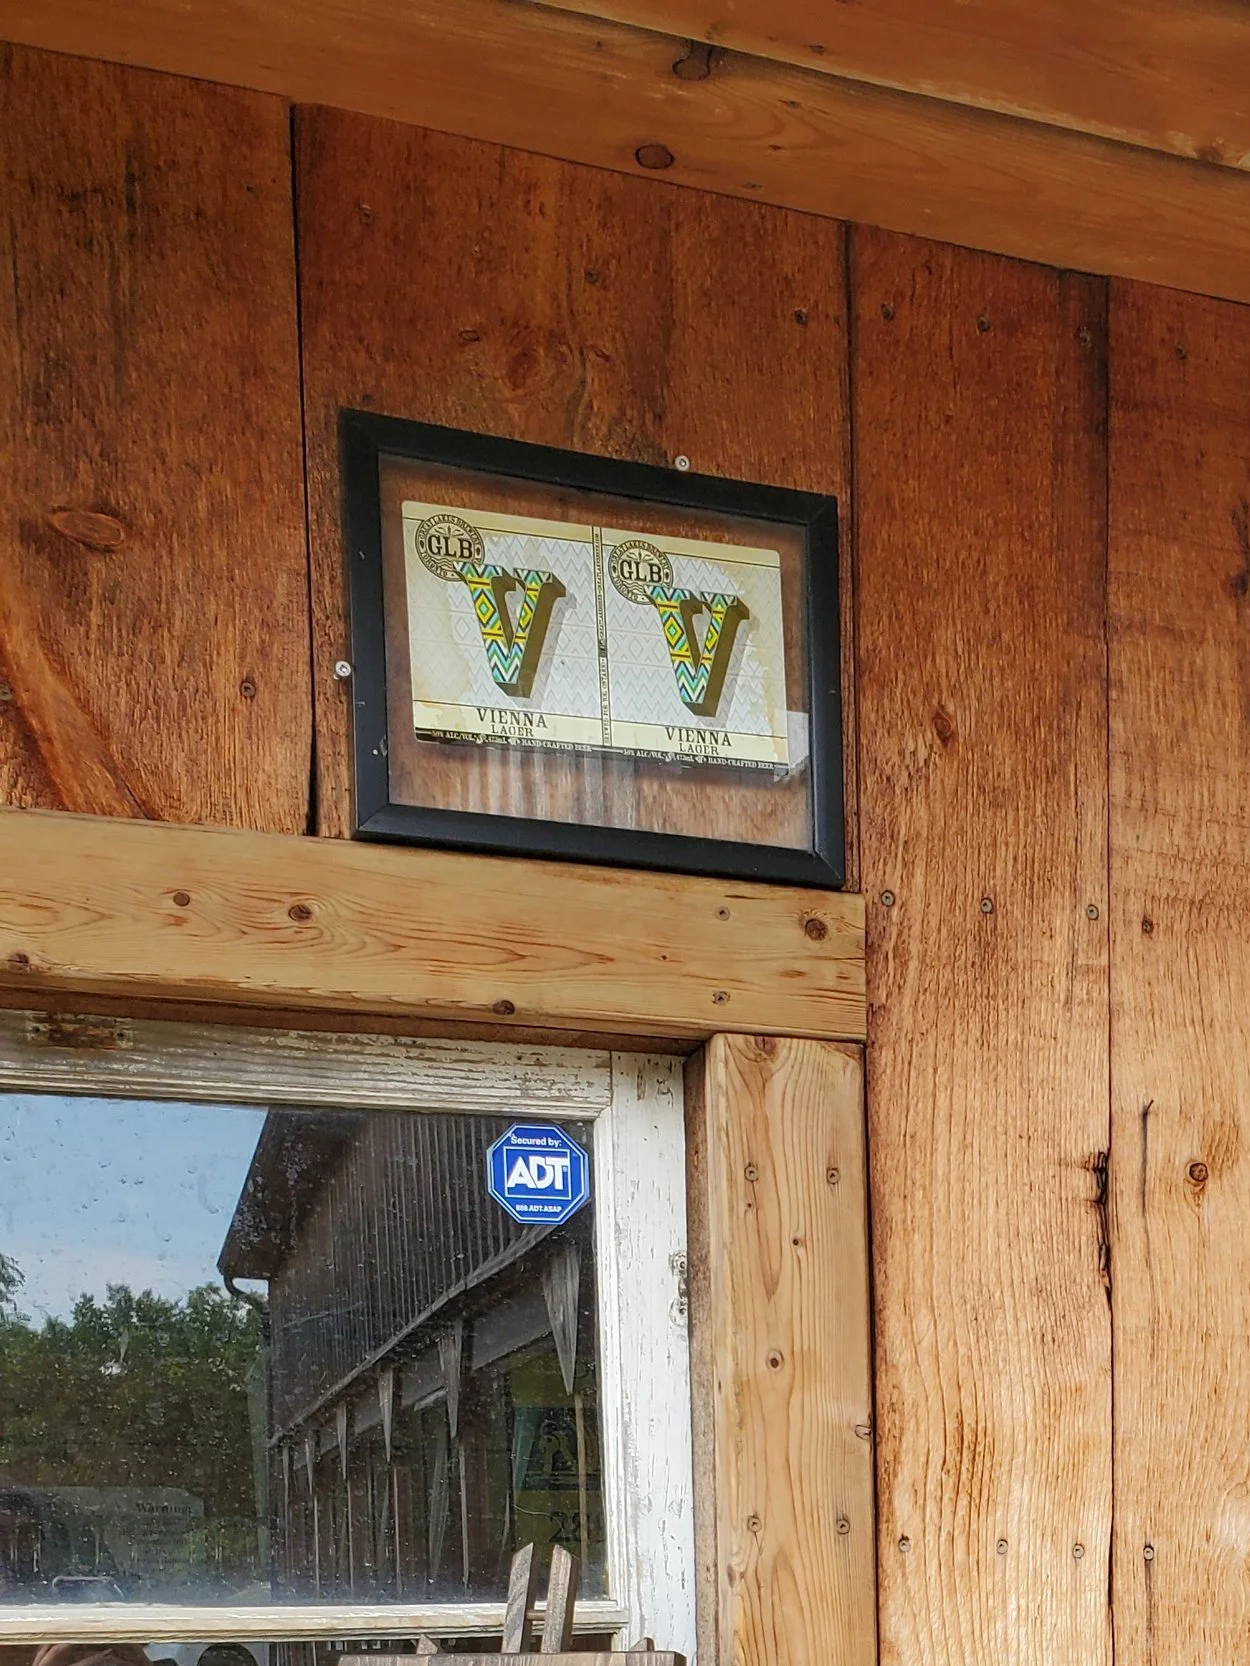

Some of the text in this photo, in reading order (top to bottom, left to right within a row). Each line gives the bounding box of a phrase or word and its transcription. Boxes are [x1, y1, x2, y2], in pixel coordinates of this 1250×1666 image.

[427, 534, 473, 560] GLB
[619, 559, 662, 584] GLB
[476, 707, 548, 729] VIENNA
[665, 727, 732, 747] VIENNA
[510, 1136, 562, 1148] Secured by:
[507, 1156, 569, 1190] ADT
